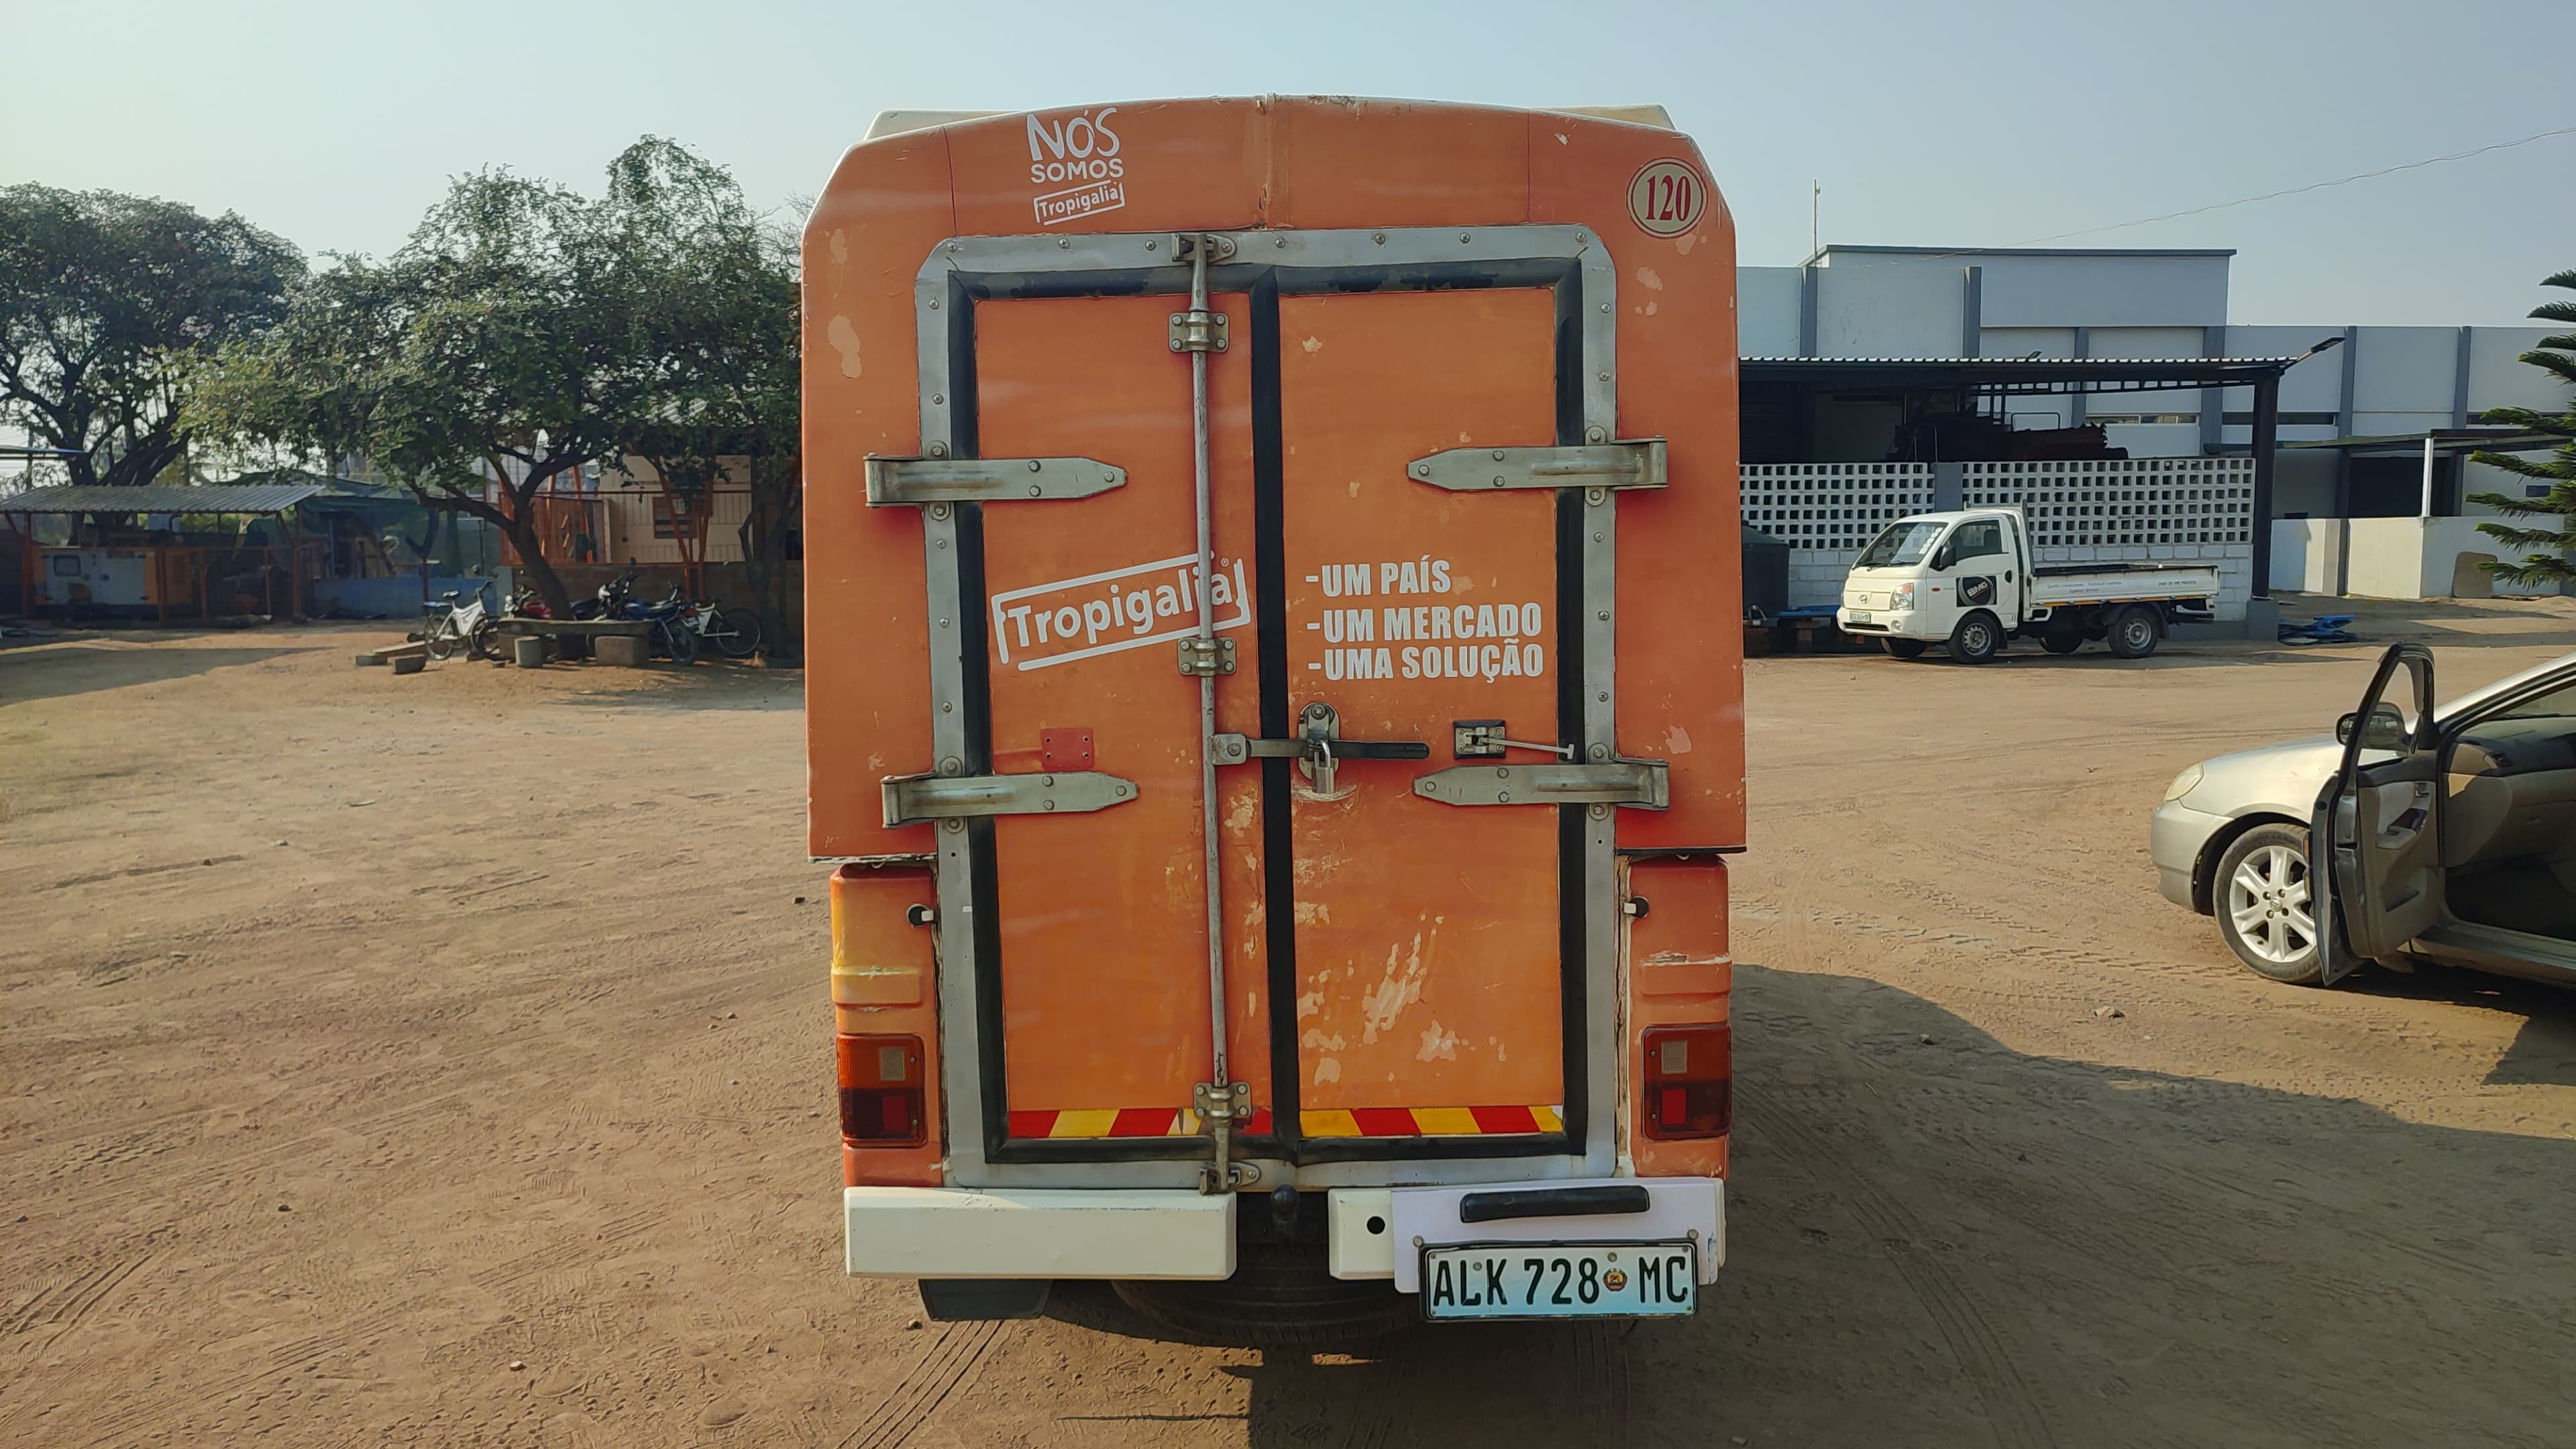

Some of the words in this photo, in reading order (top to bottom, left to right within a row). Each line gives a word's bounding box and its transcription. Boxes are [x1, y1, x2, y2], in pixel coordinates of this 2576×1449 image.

[1026, 107, 1120, 161] NÓS
[1030, 158, 1124, 183] SOMOS
[1039, 184, 1118, 217] Tropigalia
[1645, 174, 1690, 222] 120
[1380, 554, 1451, 594] PAÍS
[1384, 602, 1542, 641] MERCADO
[1401, 638, 1544, 684] SOLUÇÃO
[1433, 1258, 1507, 1307] ALK
[1523, 1256, 1600, 1305] 728
[1638, 1256, 1688, 1304] MC
